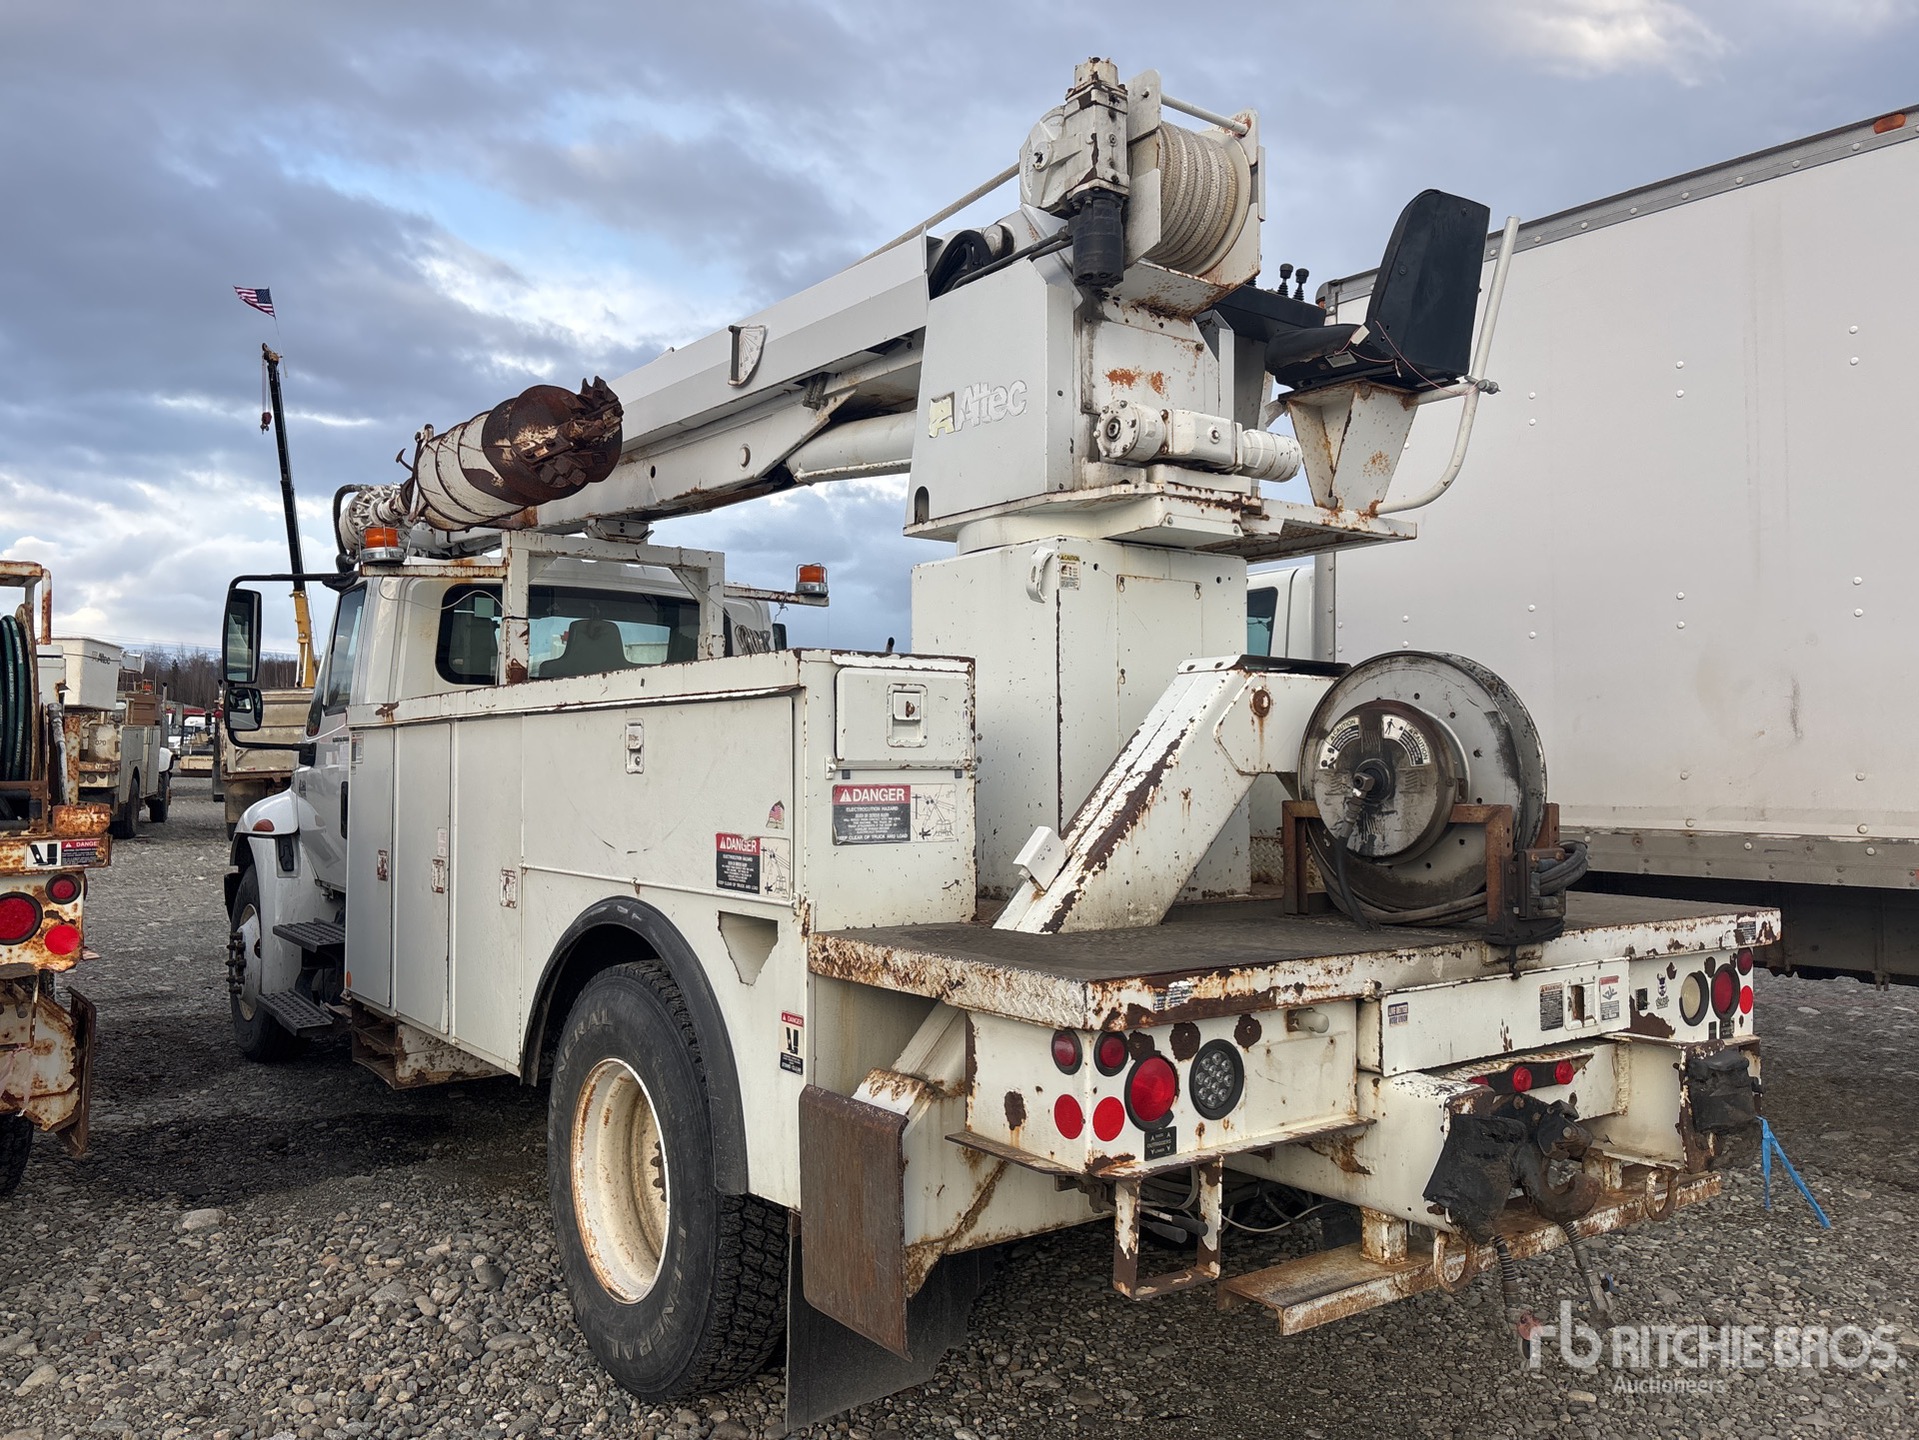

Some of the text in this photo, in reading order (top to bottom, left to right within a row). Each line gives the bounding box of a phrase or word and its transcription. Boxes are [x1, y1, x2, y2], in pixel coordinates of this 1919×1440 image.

[954, 379, 1028, 432] Altec
[1333, 718, 1356, 736] CAUTION
[1412, 730, 1429, 760] CAUTION
[852, 788, 905, 802] DANGER
[726, 837, 757, 853] DANGER
[786, 1015, 803, 1026] DANGER
